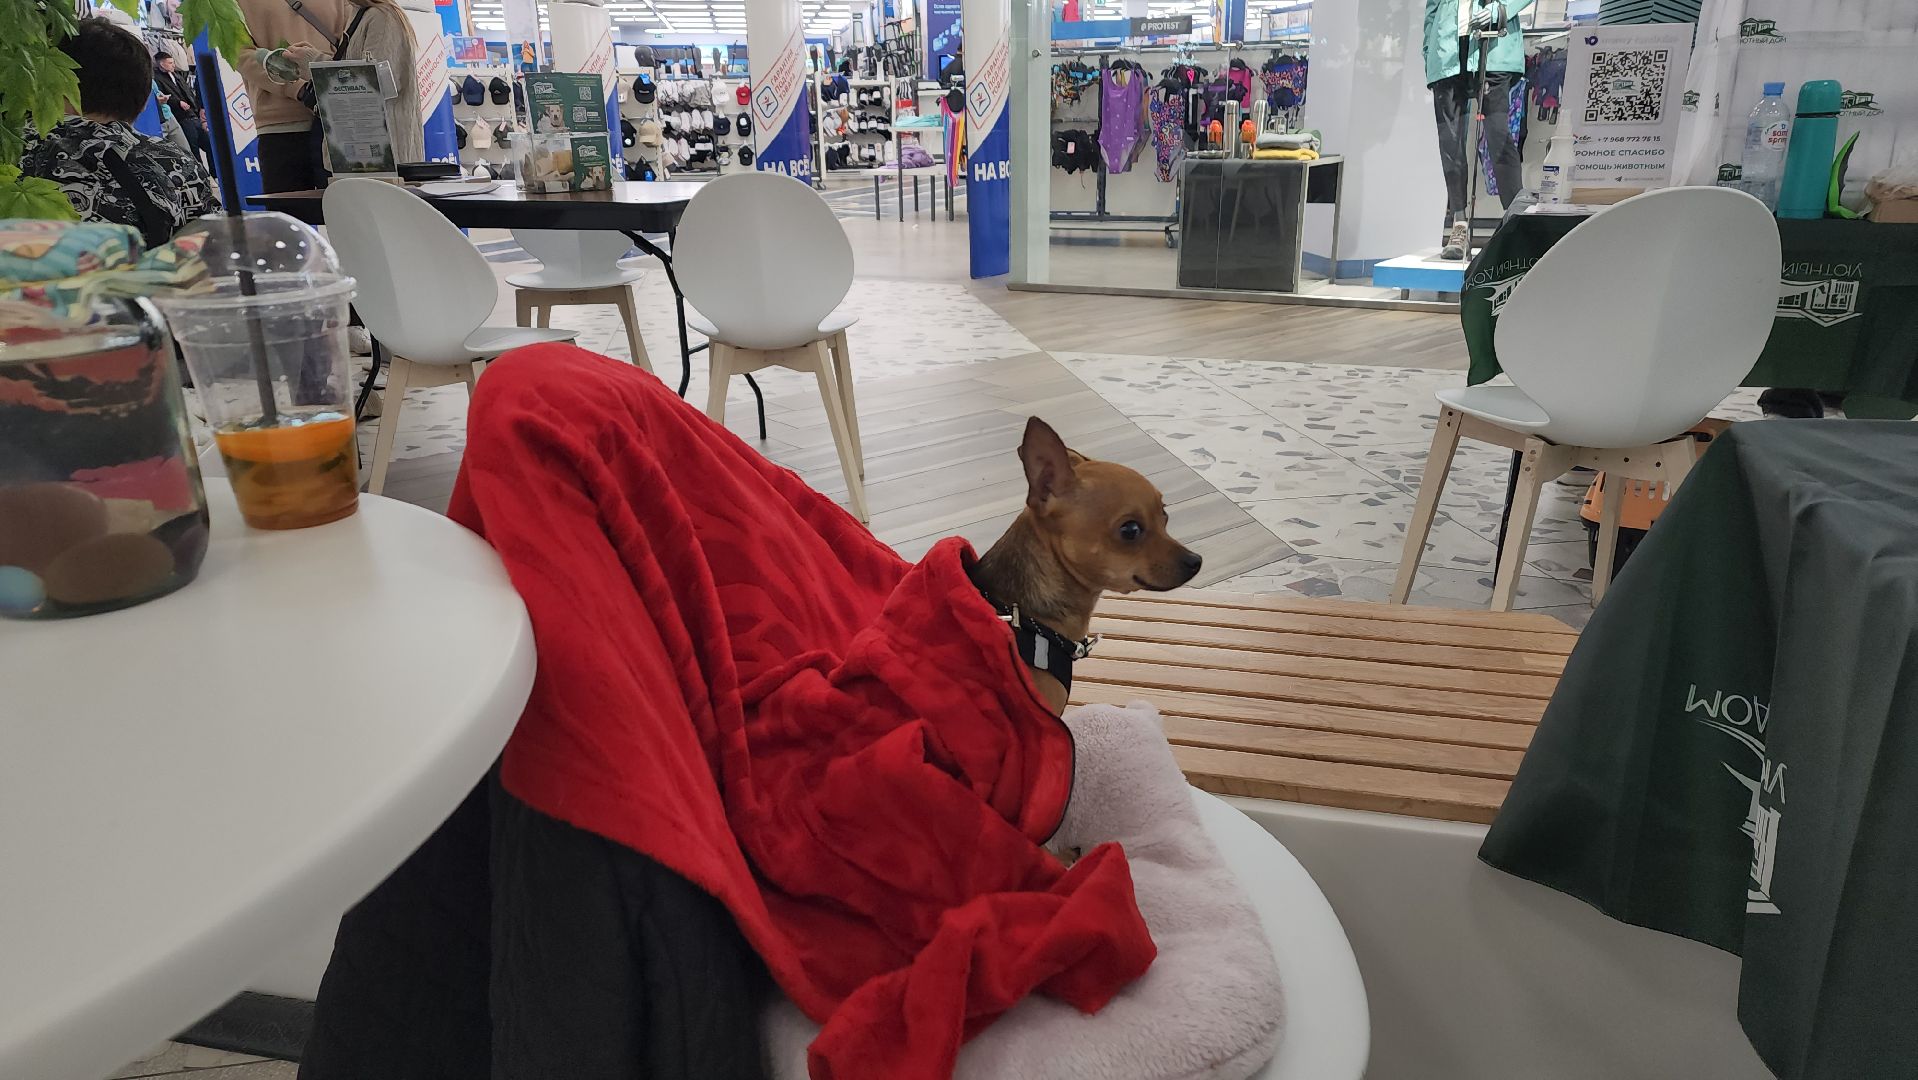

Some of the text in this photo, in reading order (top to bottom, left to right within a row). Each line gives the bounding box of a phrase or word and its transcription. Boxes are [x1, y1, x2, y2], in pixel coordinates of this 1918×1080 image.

[1147, 22, 1180, 31] PROTEST
[420, 80, 435, 101] ОВАРА
[1574, 149, 1616, 157] РОМНОЕ
[244, 156, 260, 173] Н
[763, 154, 811, 177] НА ВСЁ
[974, 162, 997, 182] НА
[1465, 257, 1540, 291] ОТНЫЙ ДОМ
[1782, 262, 1862, 278] УЮТНЫЙ
[1684, 683, 1771, 734] ДОМ
